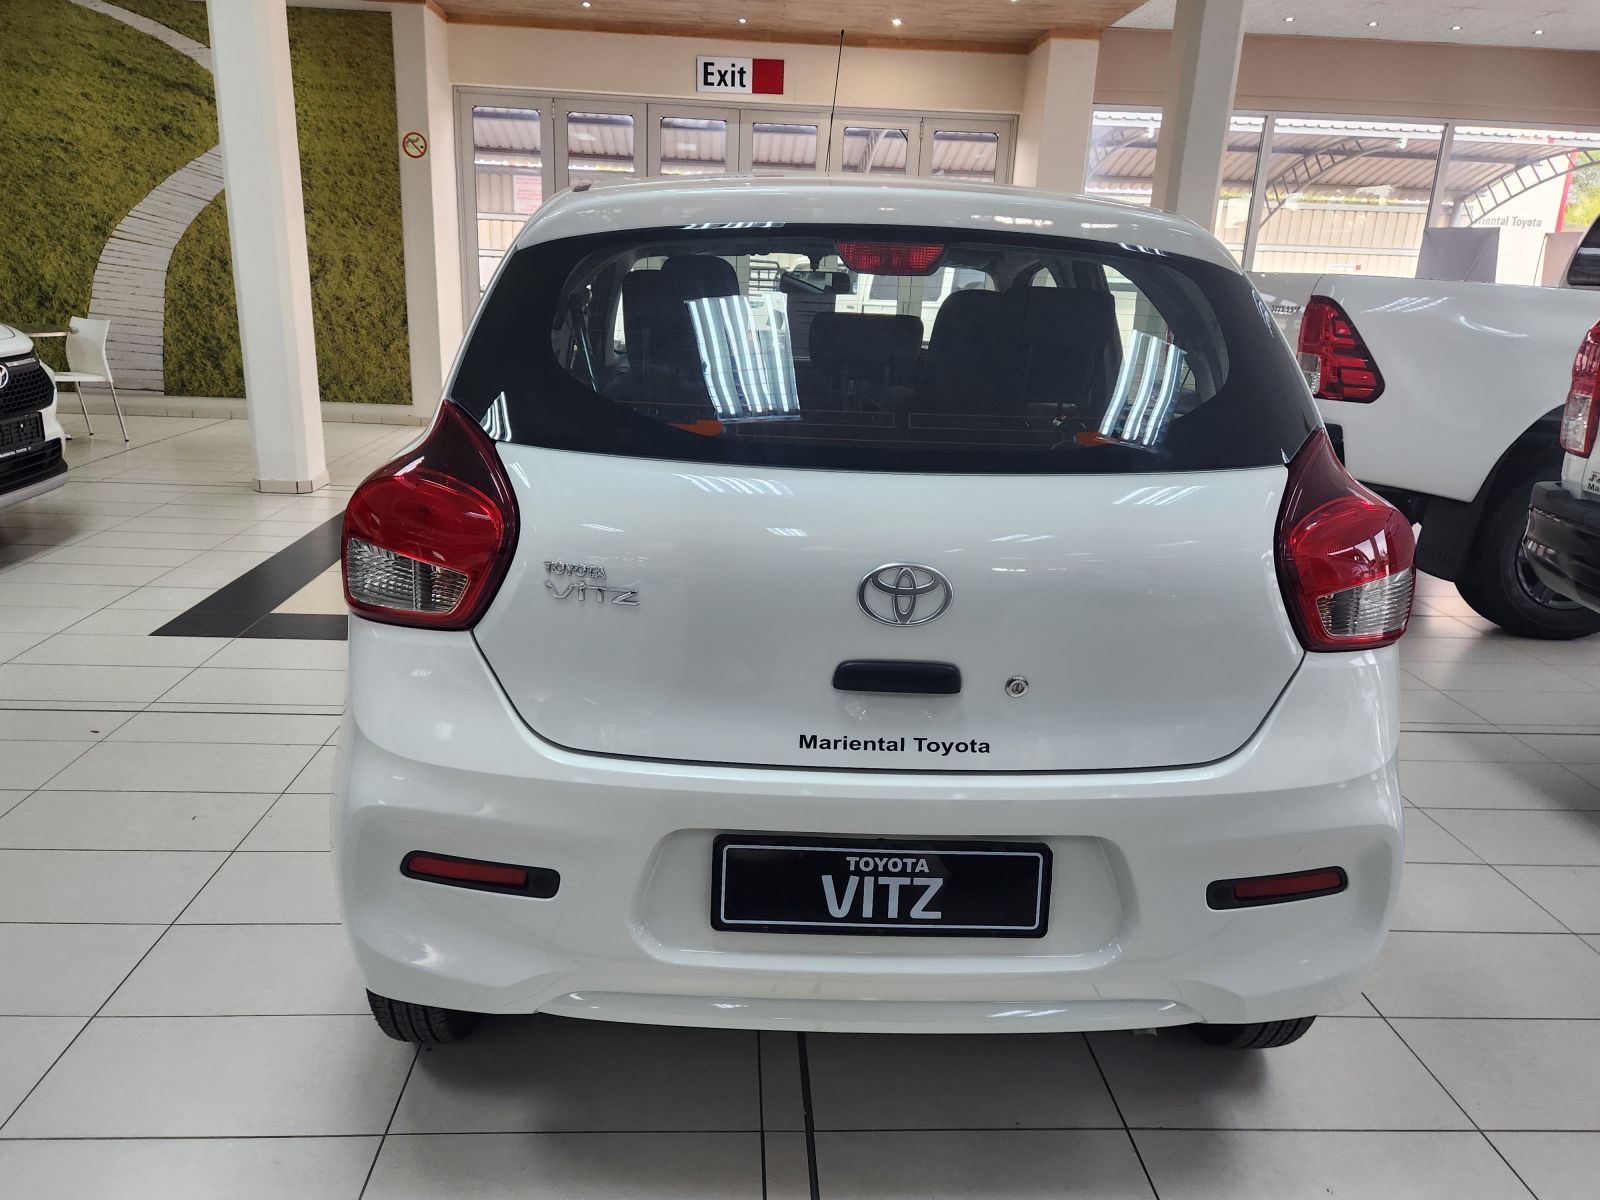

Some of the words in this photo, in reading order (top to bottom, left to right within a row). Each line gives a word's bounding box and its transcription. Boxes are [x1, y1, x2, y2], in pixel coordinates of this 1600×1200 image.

[703, 61, 746, 88] Exit
[1512, 216, 1542, 229] Toyota
[544, 560, 607, 580] TOYOTA
[544, 580, 639, 606] VITZ
[799, 734, 905, 752] Mariental
[913, 737, 990, 756] Toyota
[846, 856, 930, 873] TOYOTA
[821, 874, 944, 920] VITZ
